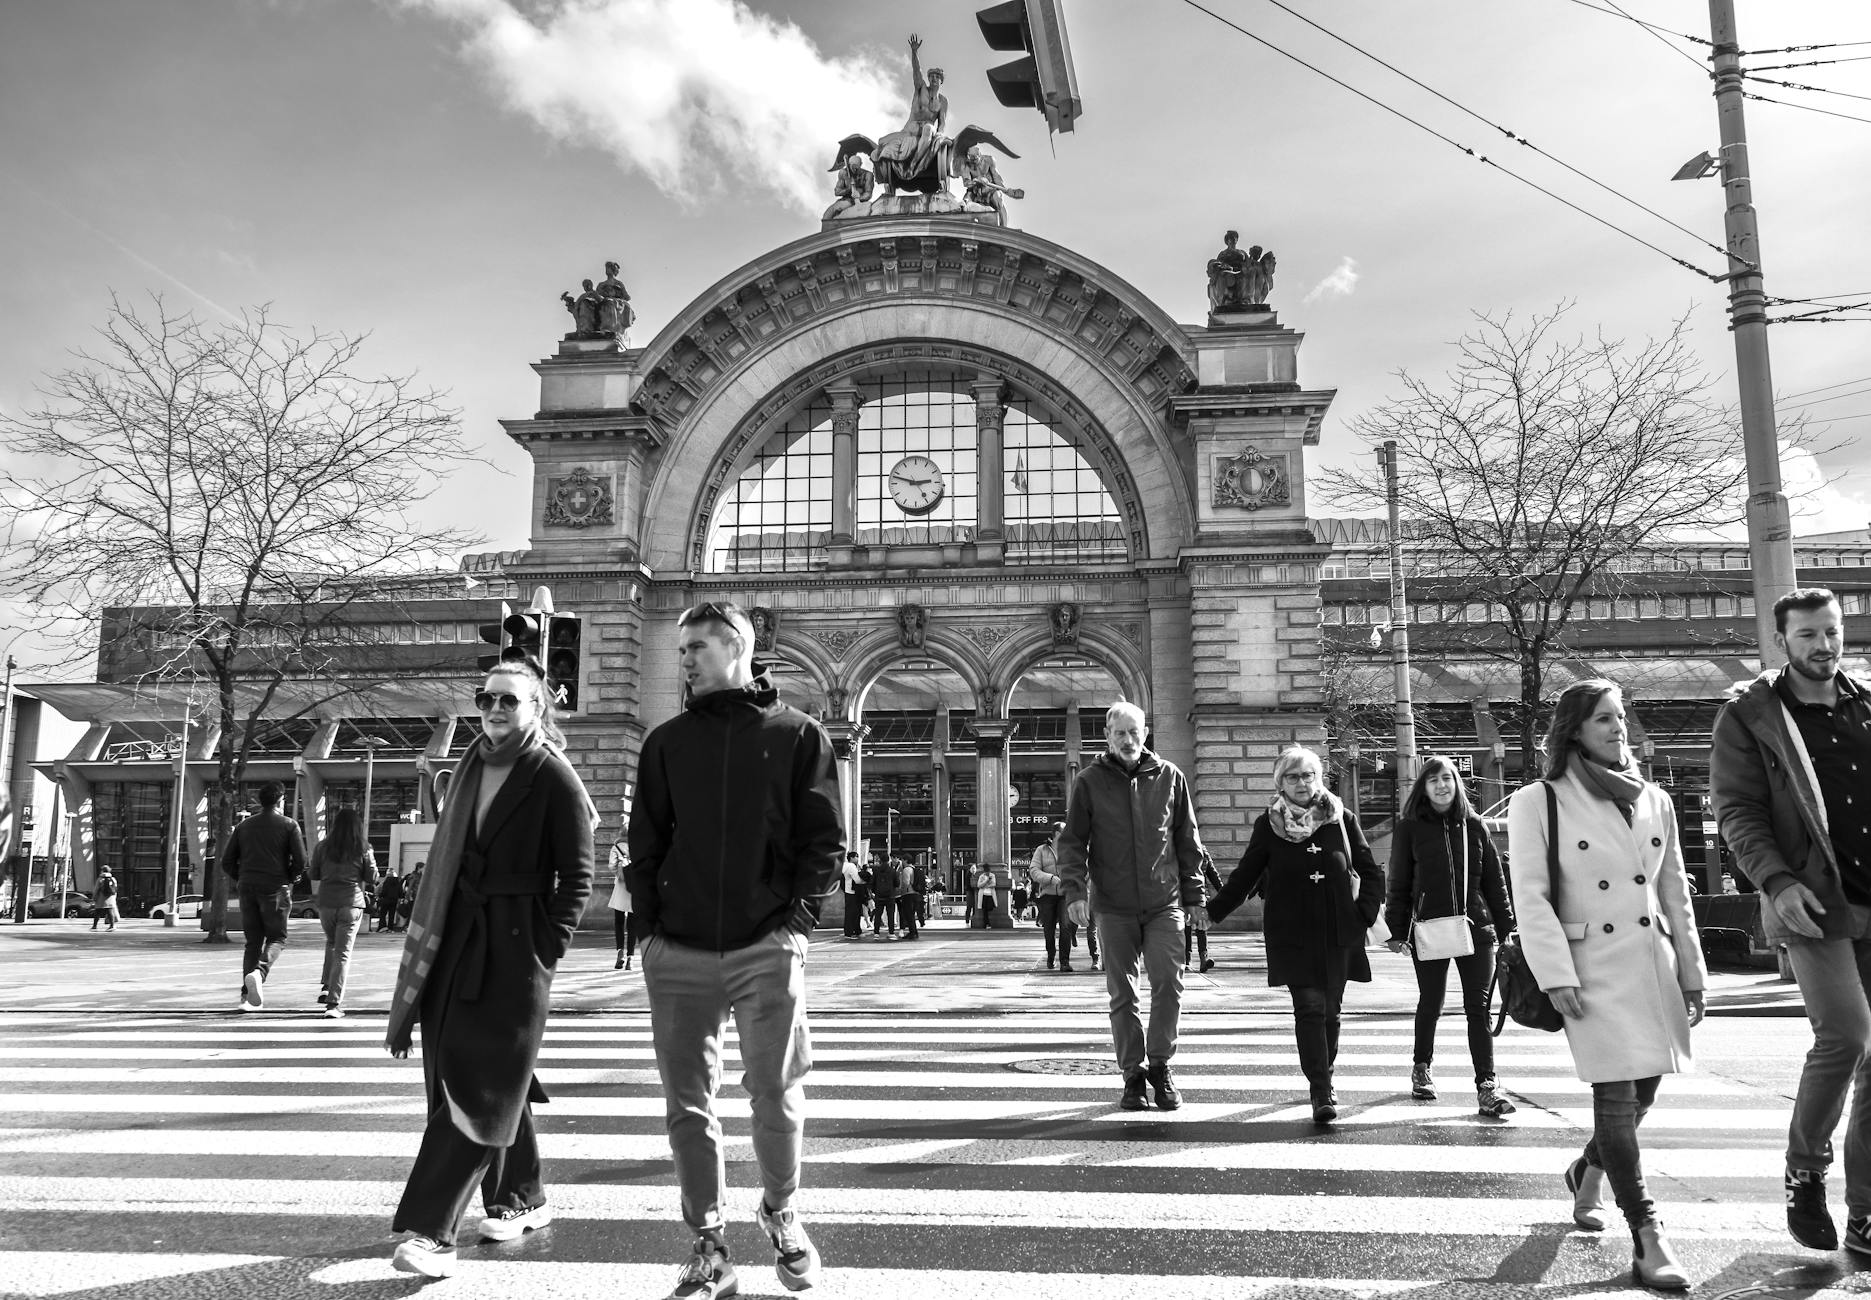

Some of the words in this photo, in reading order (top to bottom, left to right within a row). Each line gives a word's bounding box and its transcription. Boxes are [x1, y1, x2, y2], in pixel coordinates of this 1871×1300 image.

[1702, 796, 1711, 805] H
[23, 806, 31, 815] R
[1016, 816, 1031, 824] CFF
[1033, 816, 1048, 824] FFS
